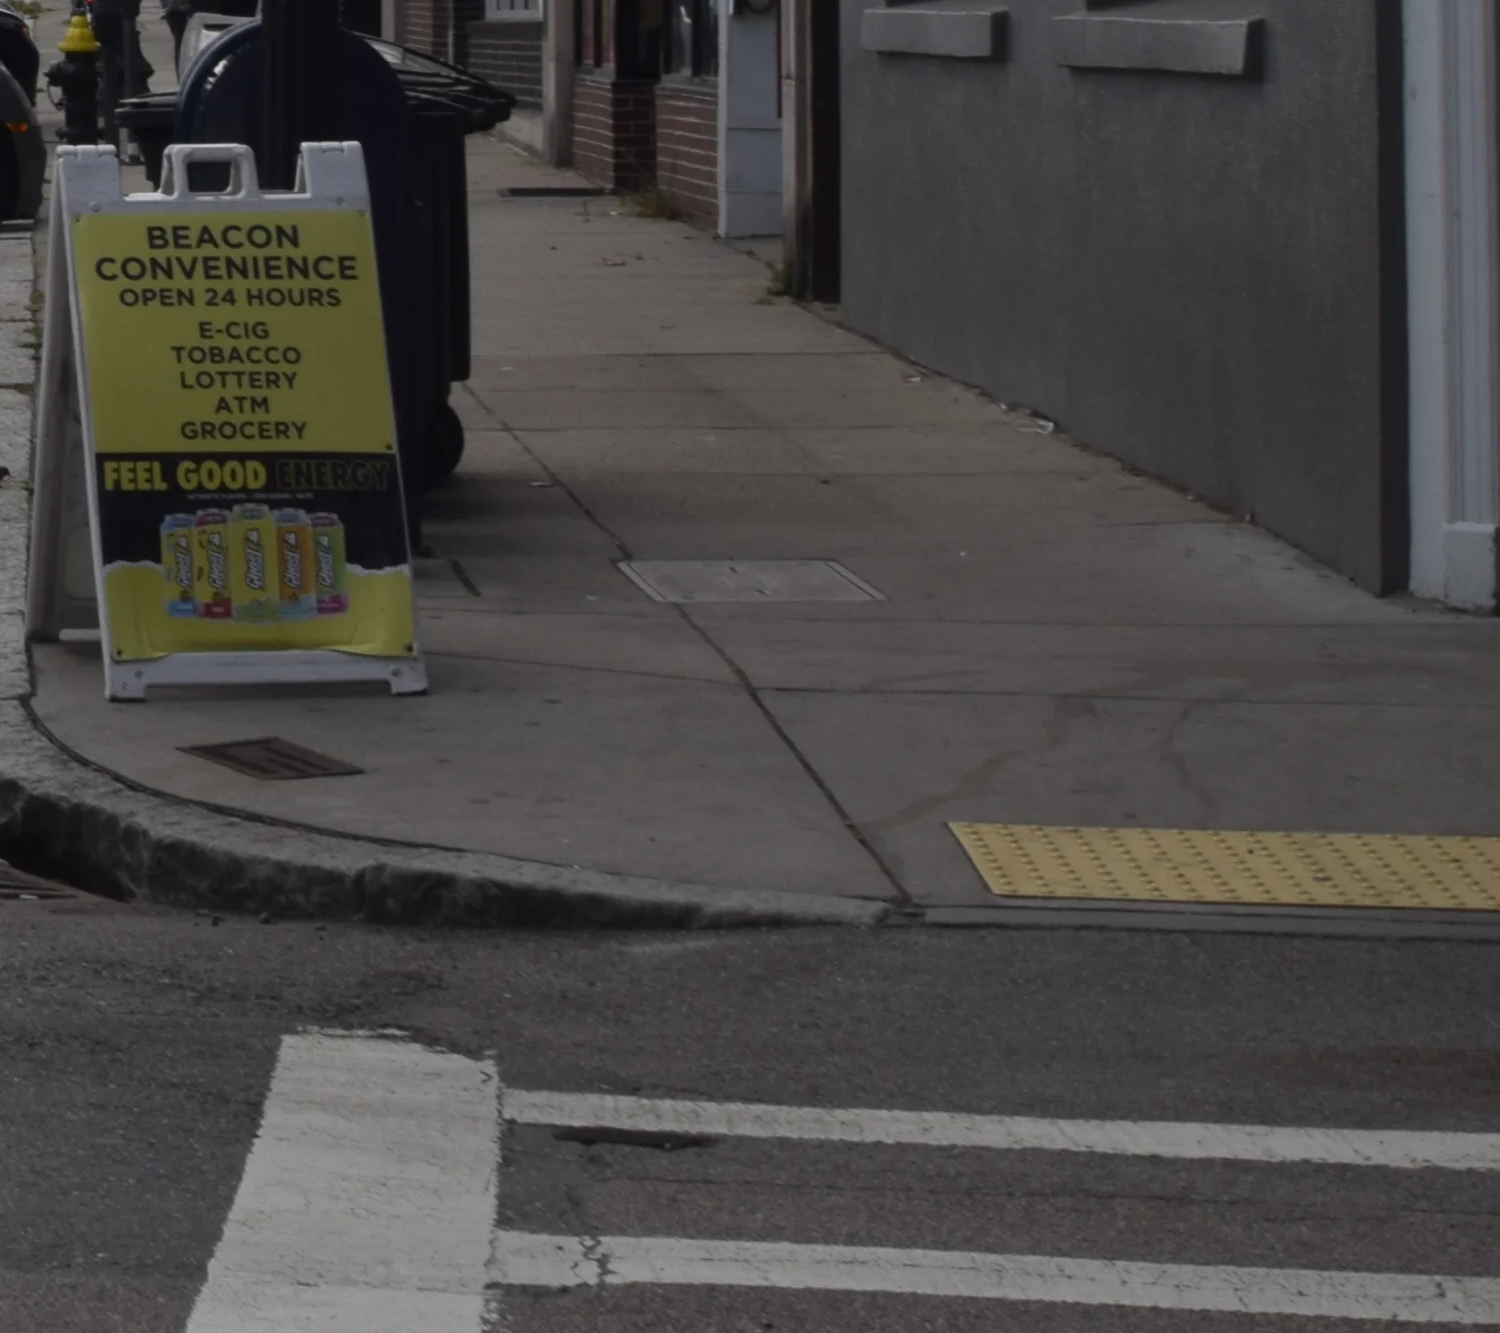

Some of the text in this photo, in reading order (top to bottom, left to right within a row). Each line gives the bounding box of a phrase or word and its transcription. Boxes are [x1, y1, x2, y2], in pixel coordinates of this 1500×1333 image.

[145, 224, 300, 250] BEACON
[94, 255, 359, 282] CONVENIENCE
[118, 287, 342, 307] OPEN 24 HOURS
[197, 321, 270, 340] E-CIG
[170, 345, 302, 365] TOBACCO
[179, 370, 298, 390] LOTTERY
[214, 396, 270, 415] ATM
[179, 421, 308, 441] GROCERY
[102, 459, 391, 492] FEEL GOOD ENERGY
